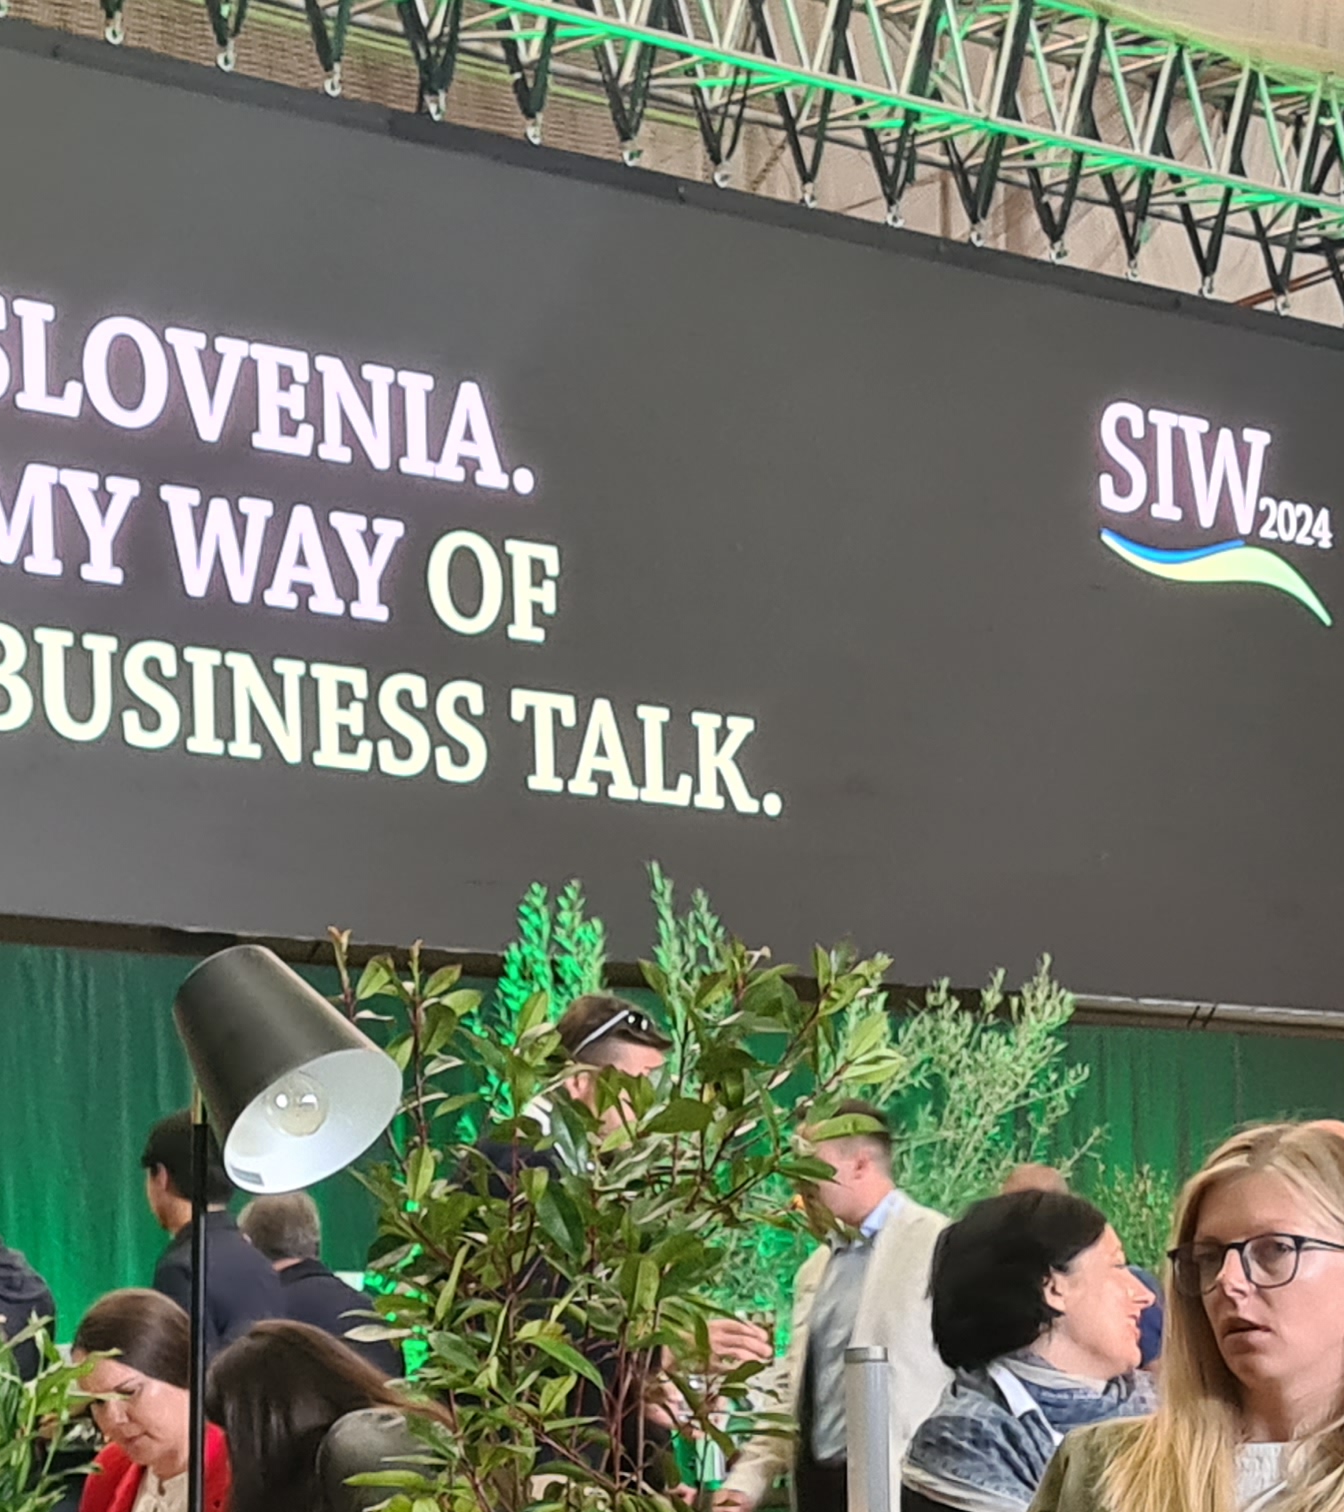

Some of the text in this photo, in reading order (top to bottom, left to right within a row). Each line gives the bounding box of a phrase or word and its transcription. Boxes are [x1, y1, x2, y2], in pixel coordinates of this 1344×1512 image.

[1098, 401, 1334, 549] SIW 2024
[159, 483, 406, 623] WAY
[426, 529, 561, 643] OF
[510, 688, 783, 817] TALK.
